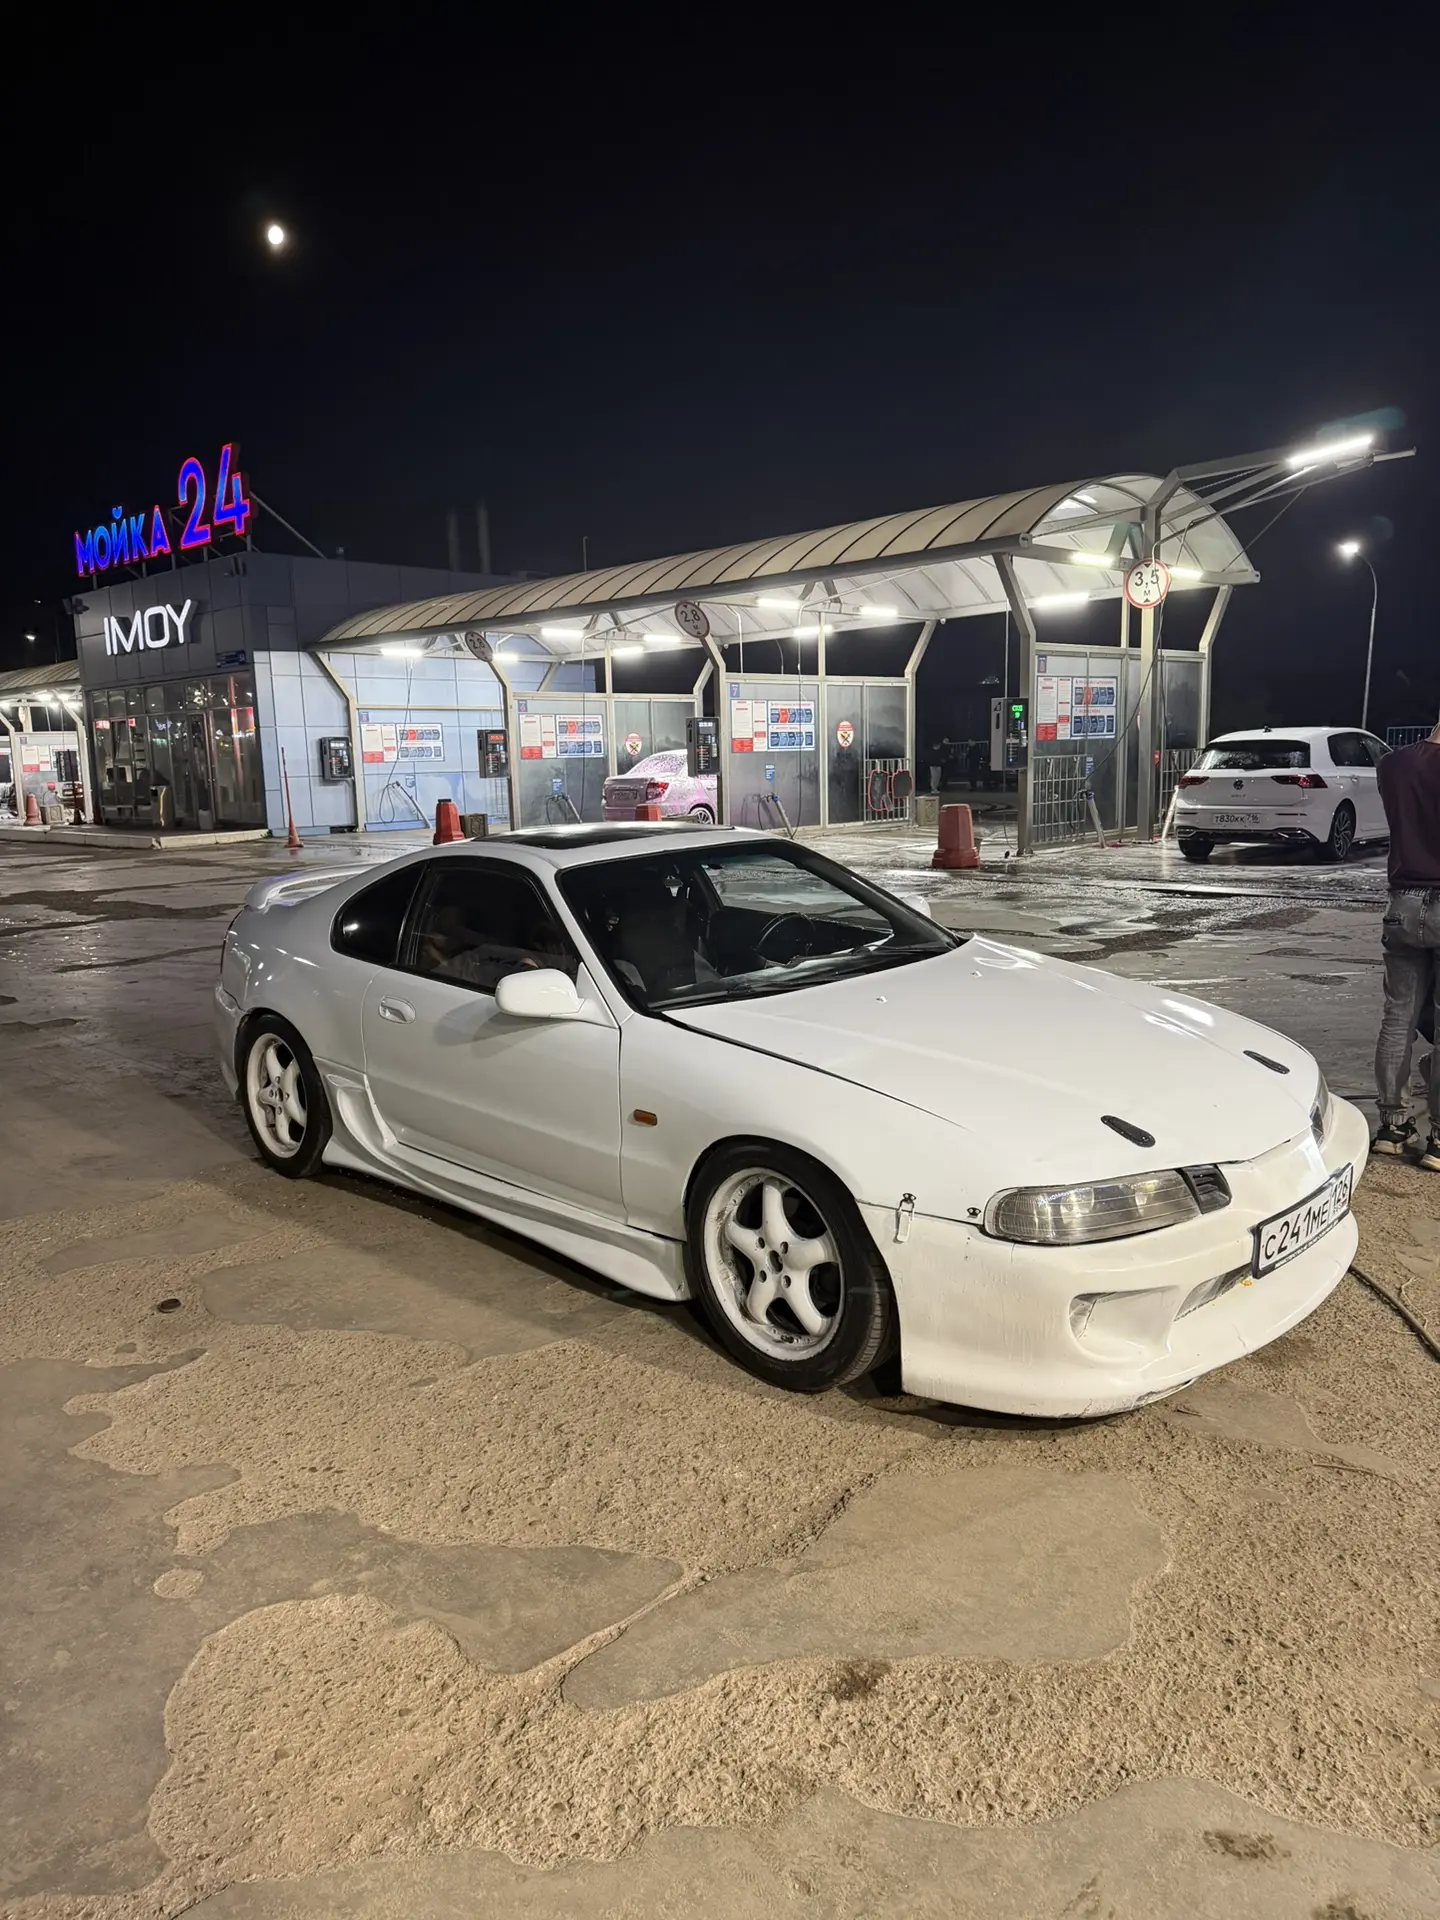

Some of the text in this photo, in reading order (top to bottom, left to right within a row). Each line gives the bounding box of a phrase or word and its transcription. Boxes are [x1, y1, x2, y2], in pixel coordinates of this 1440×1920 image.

[75, 443, 250, 577] МОЙКА 24
[1135, 569, 1159, 588] 3,5
[104, 599, 191, 656] IMOY
[680, 609, 701, 624] 2,8
[1264, 1199, 1329, 1260] С241МЕ
[1331, 1174, 1349, 1207] 126
